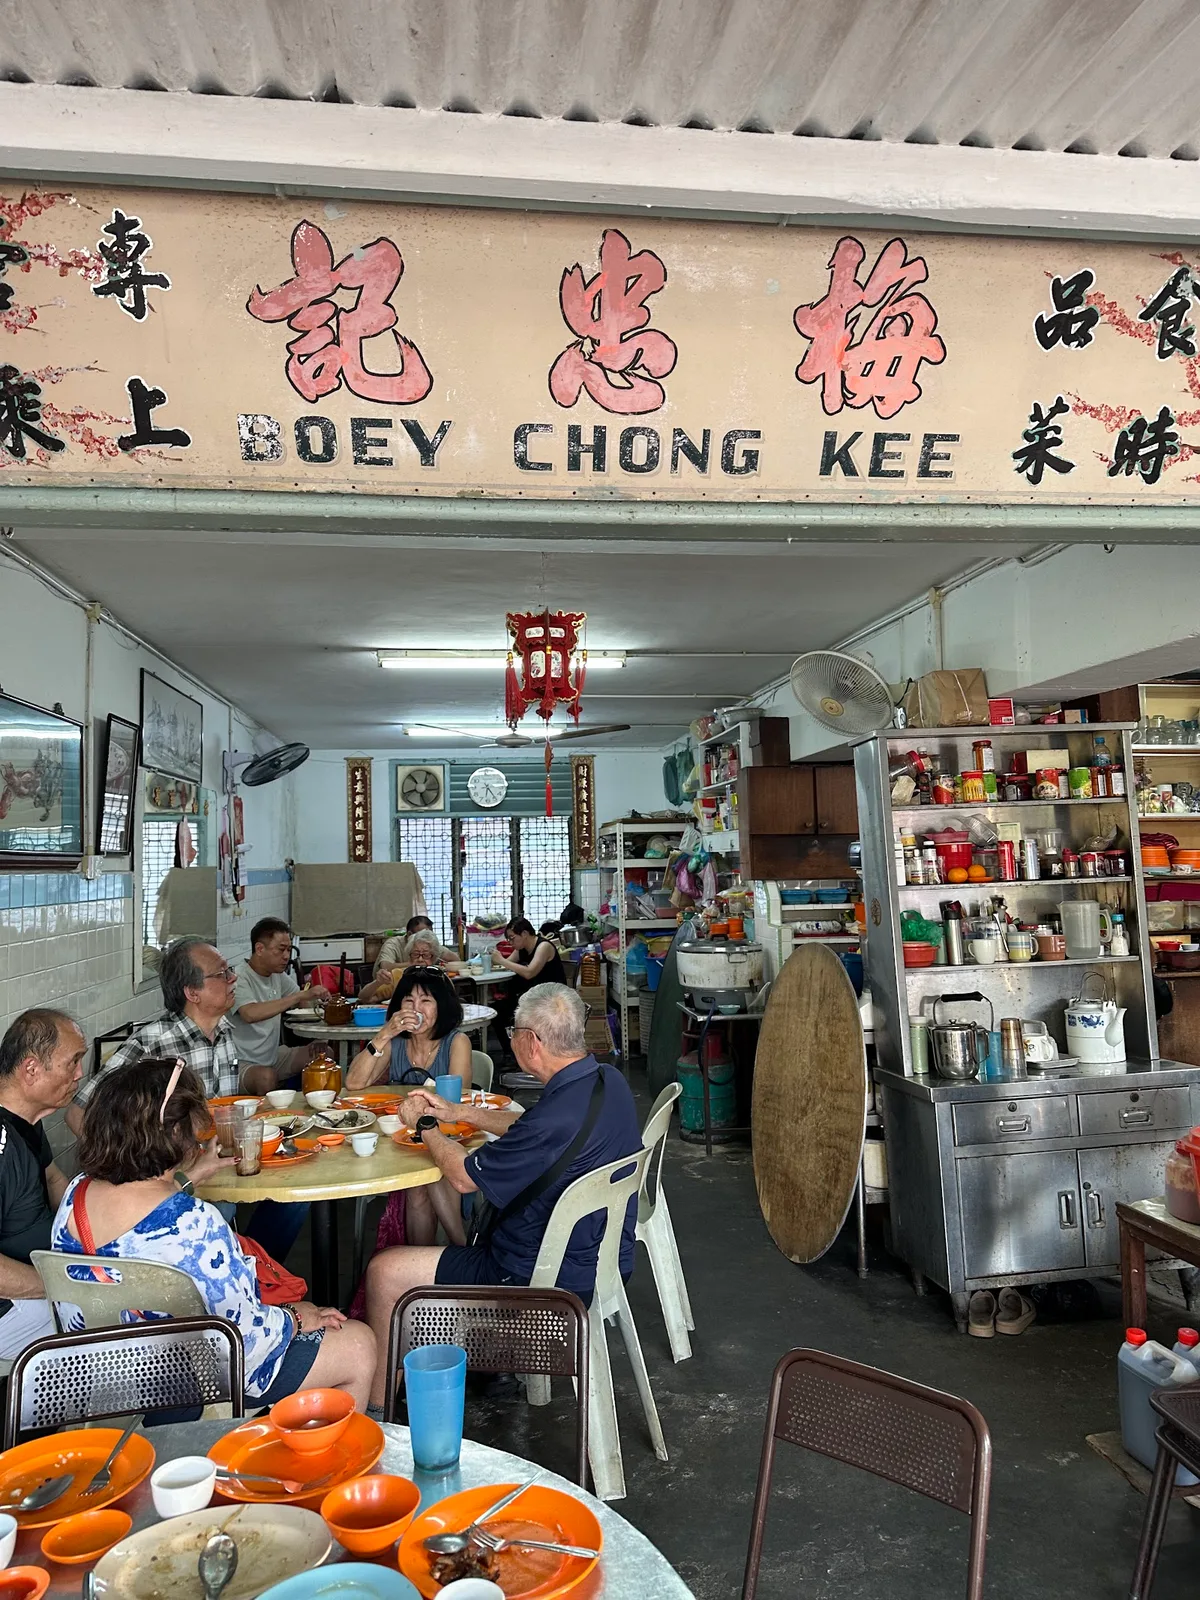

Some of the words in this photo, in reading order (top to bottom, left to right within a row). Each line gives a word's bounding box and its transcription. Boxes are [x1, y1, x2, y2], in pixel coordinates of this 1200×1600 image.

[237, 413, 453, 467] BOEY
[514, 423, 762, 475] CHONG
[819, 431, 961, 478] KEE
